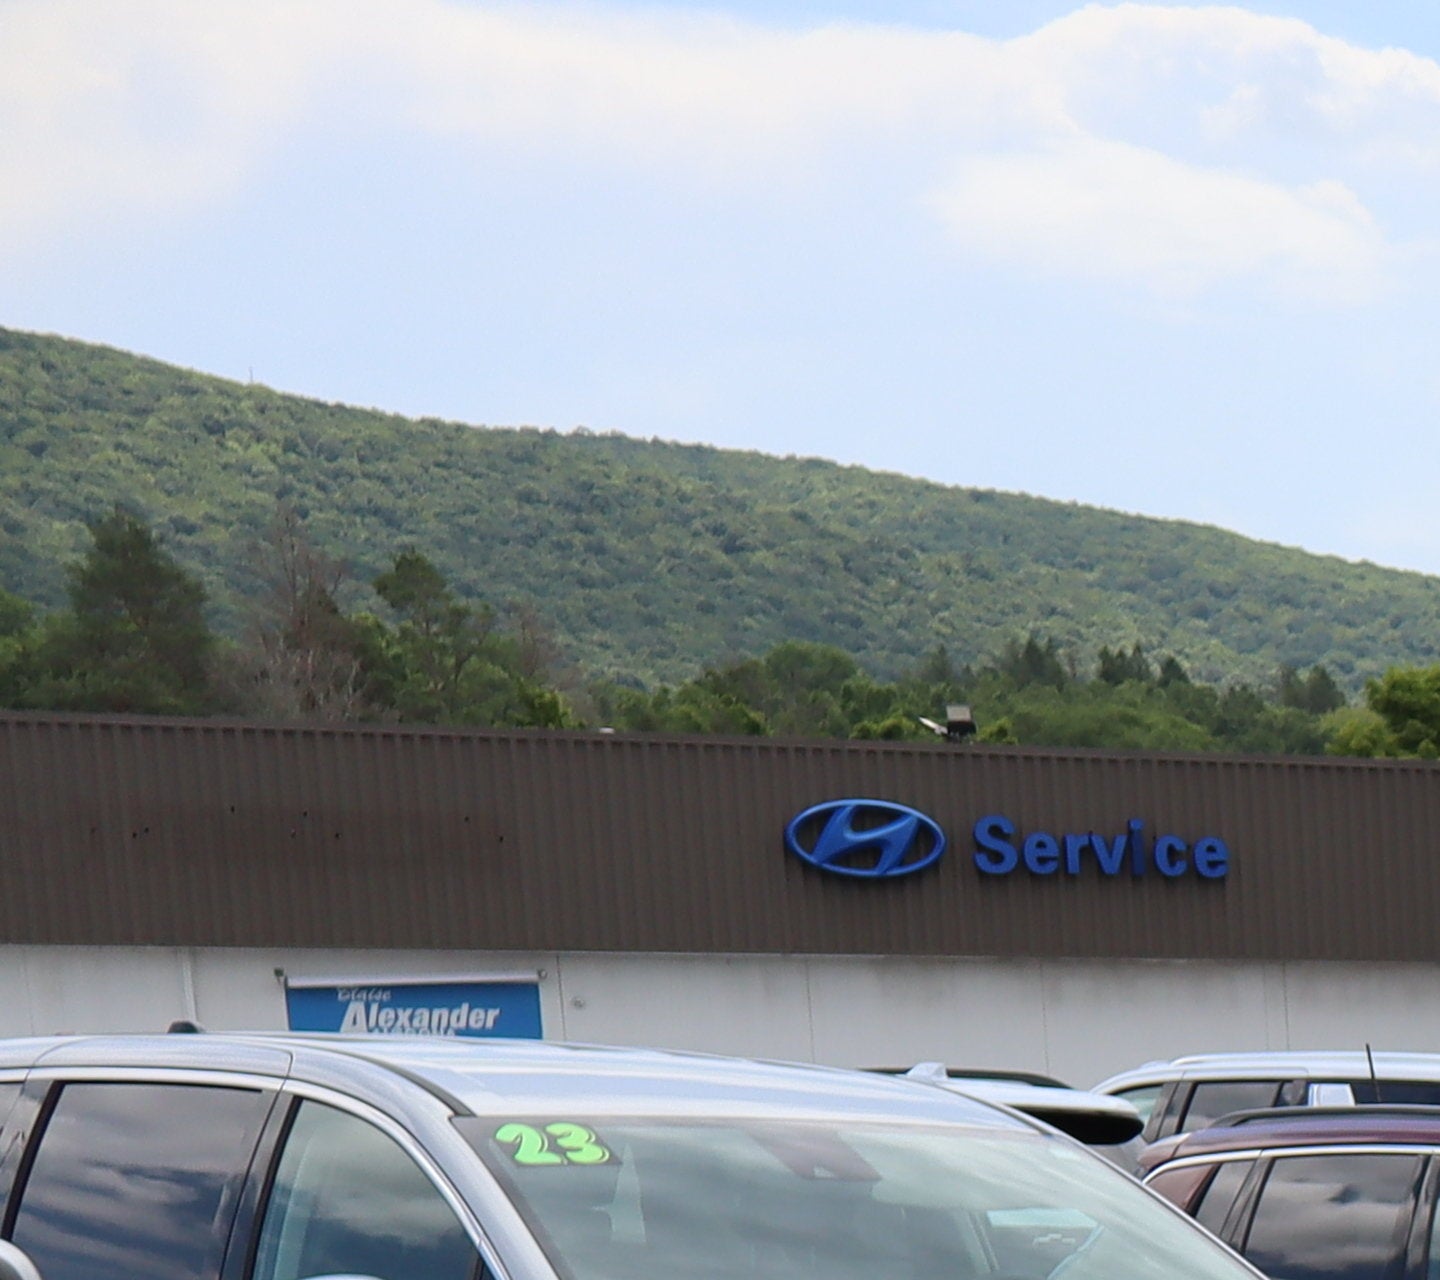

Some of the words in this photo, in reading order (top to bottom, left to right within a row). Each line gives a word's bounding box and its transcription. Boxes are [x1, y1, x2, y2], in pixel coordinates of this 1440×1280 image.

[973, 815, 1229, 877] Service
[339, 1001, 500, 1033] Alexander
[495, 1122, 610, 1165] 23
